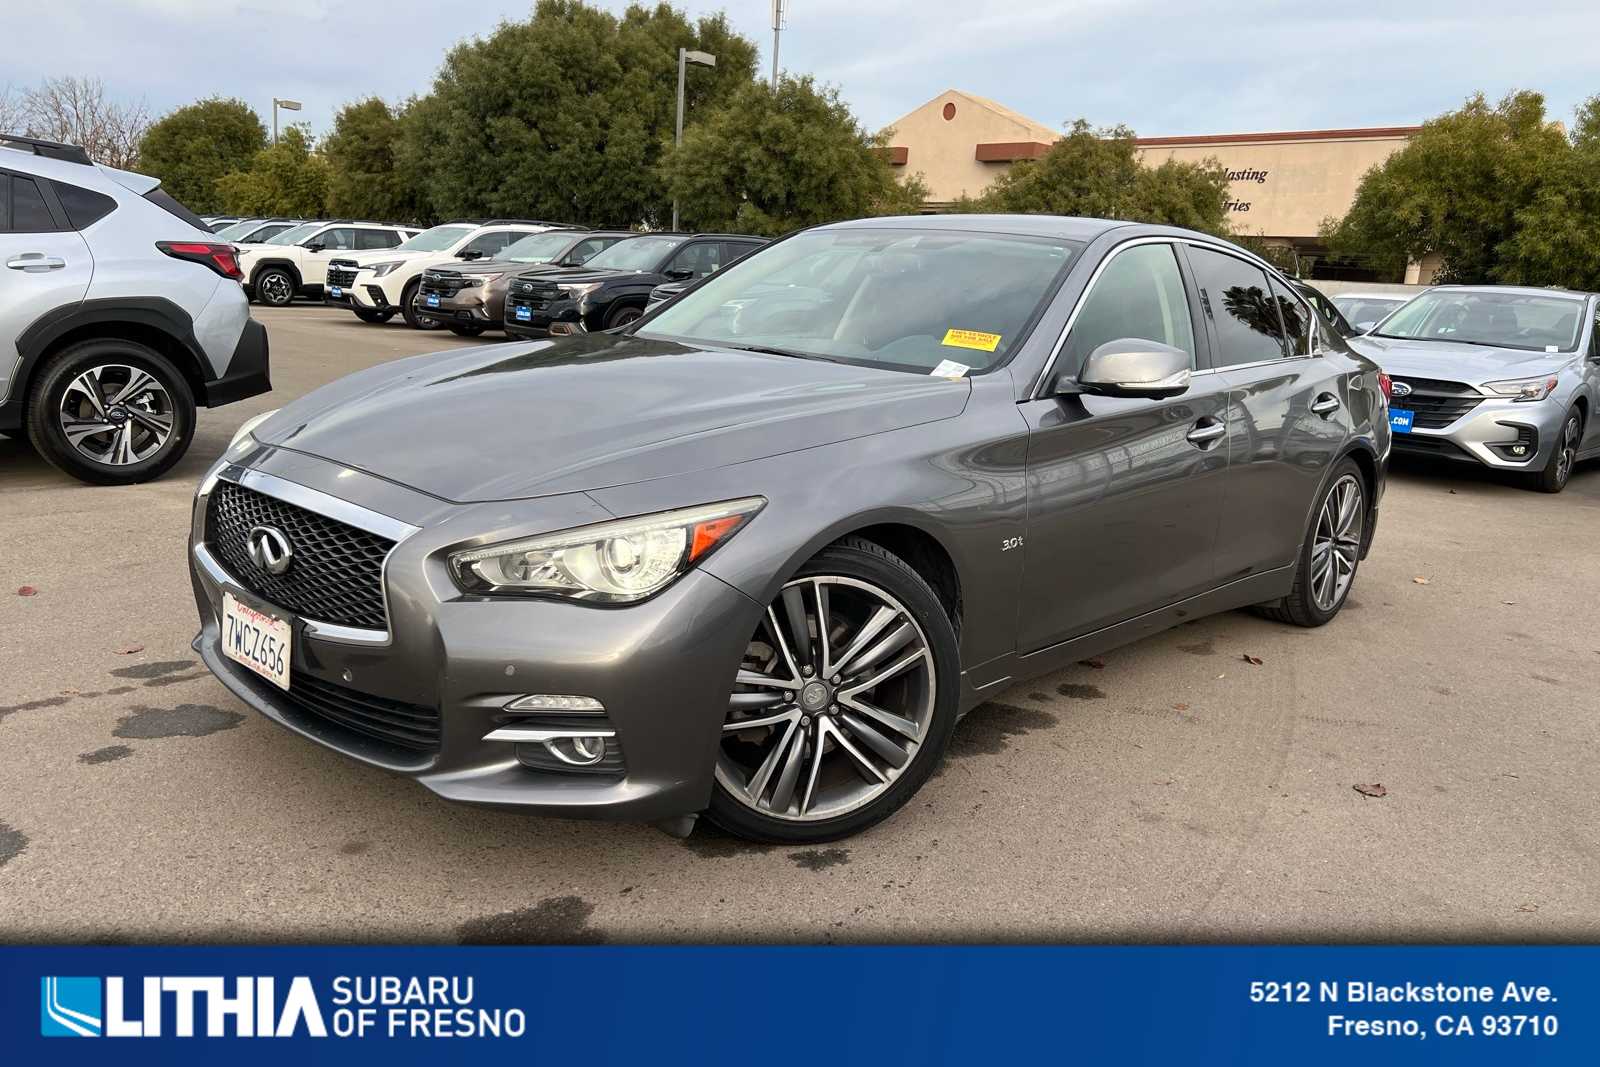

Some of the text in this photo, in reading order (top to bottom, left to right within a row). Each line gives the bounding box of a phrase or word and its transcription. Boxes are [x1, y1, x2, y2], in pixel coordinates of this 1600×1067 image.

[1222, 168, 1268, 184] lasting
[1223, 199, 1252, 212] tries
[1391, 416, 1410, 426] .COM
[227, 613, 285, 676] 7WCZ656
